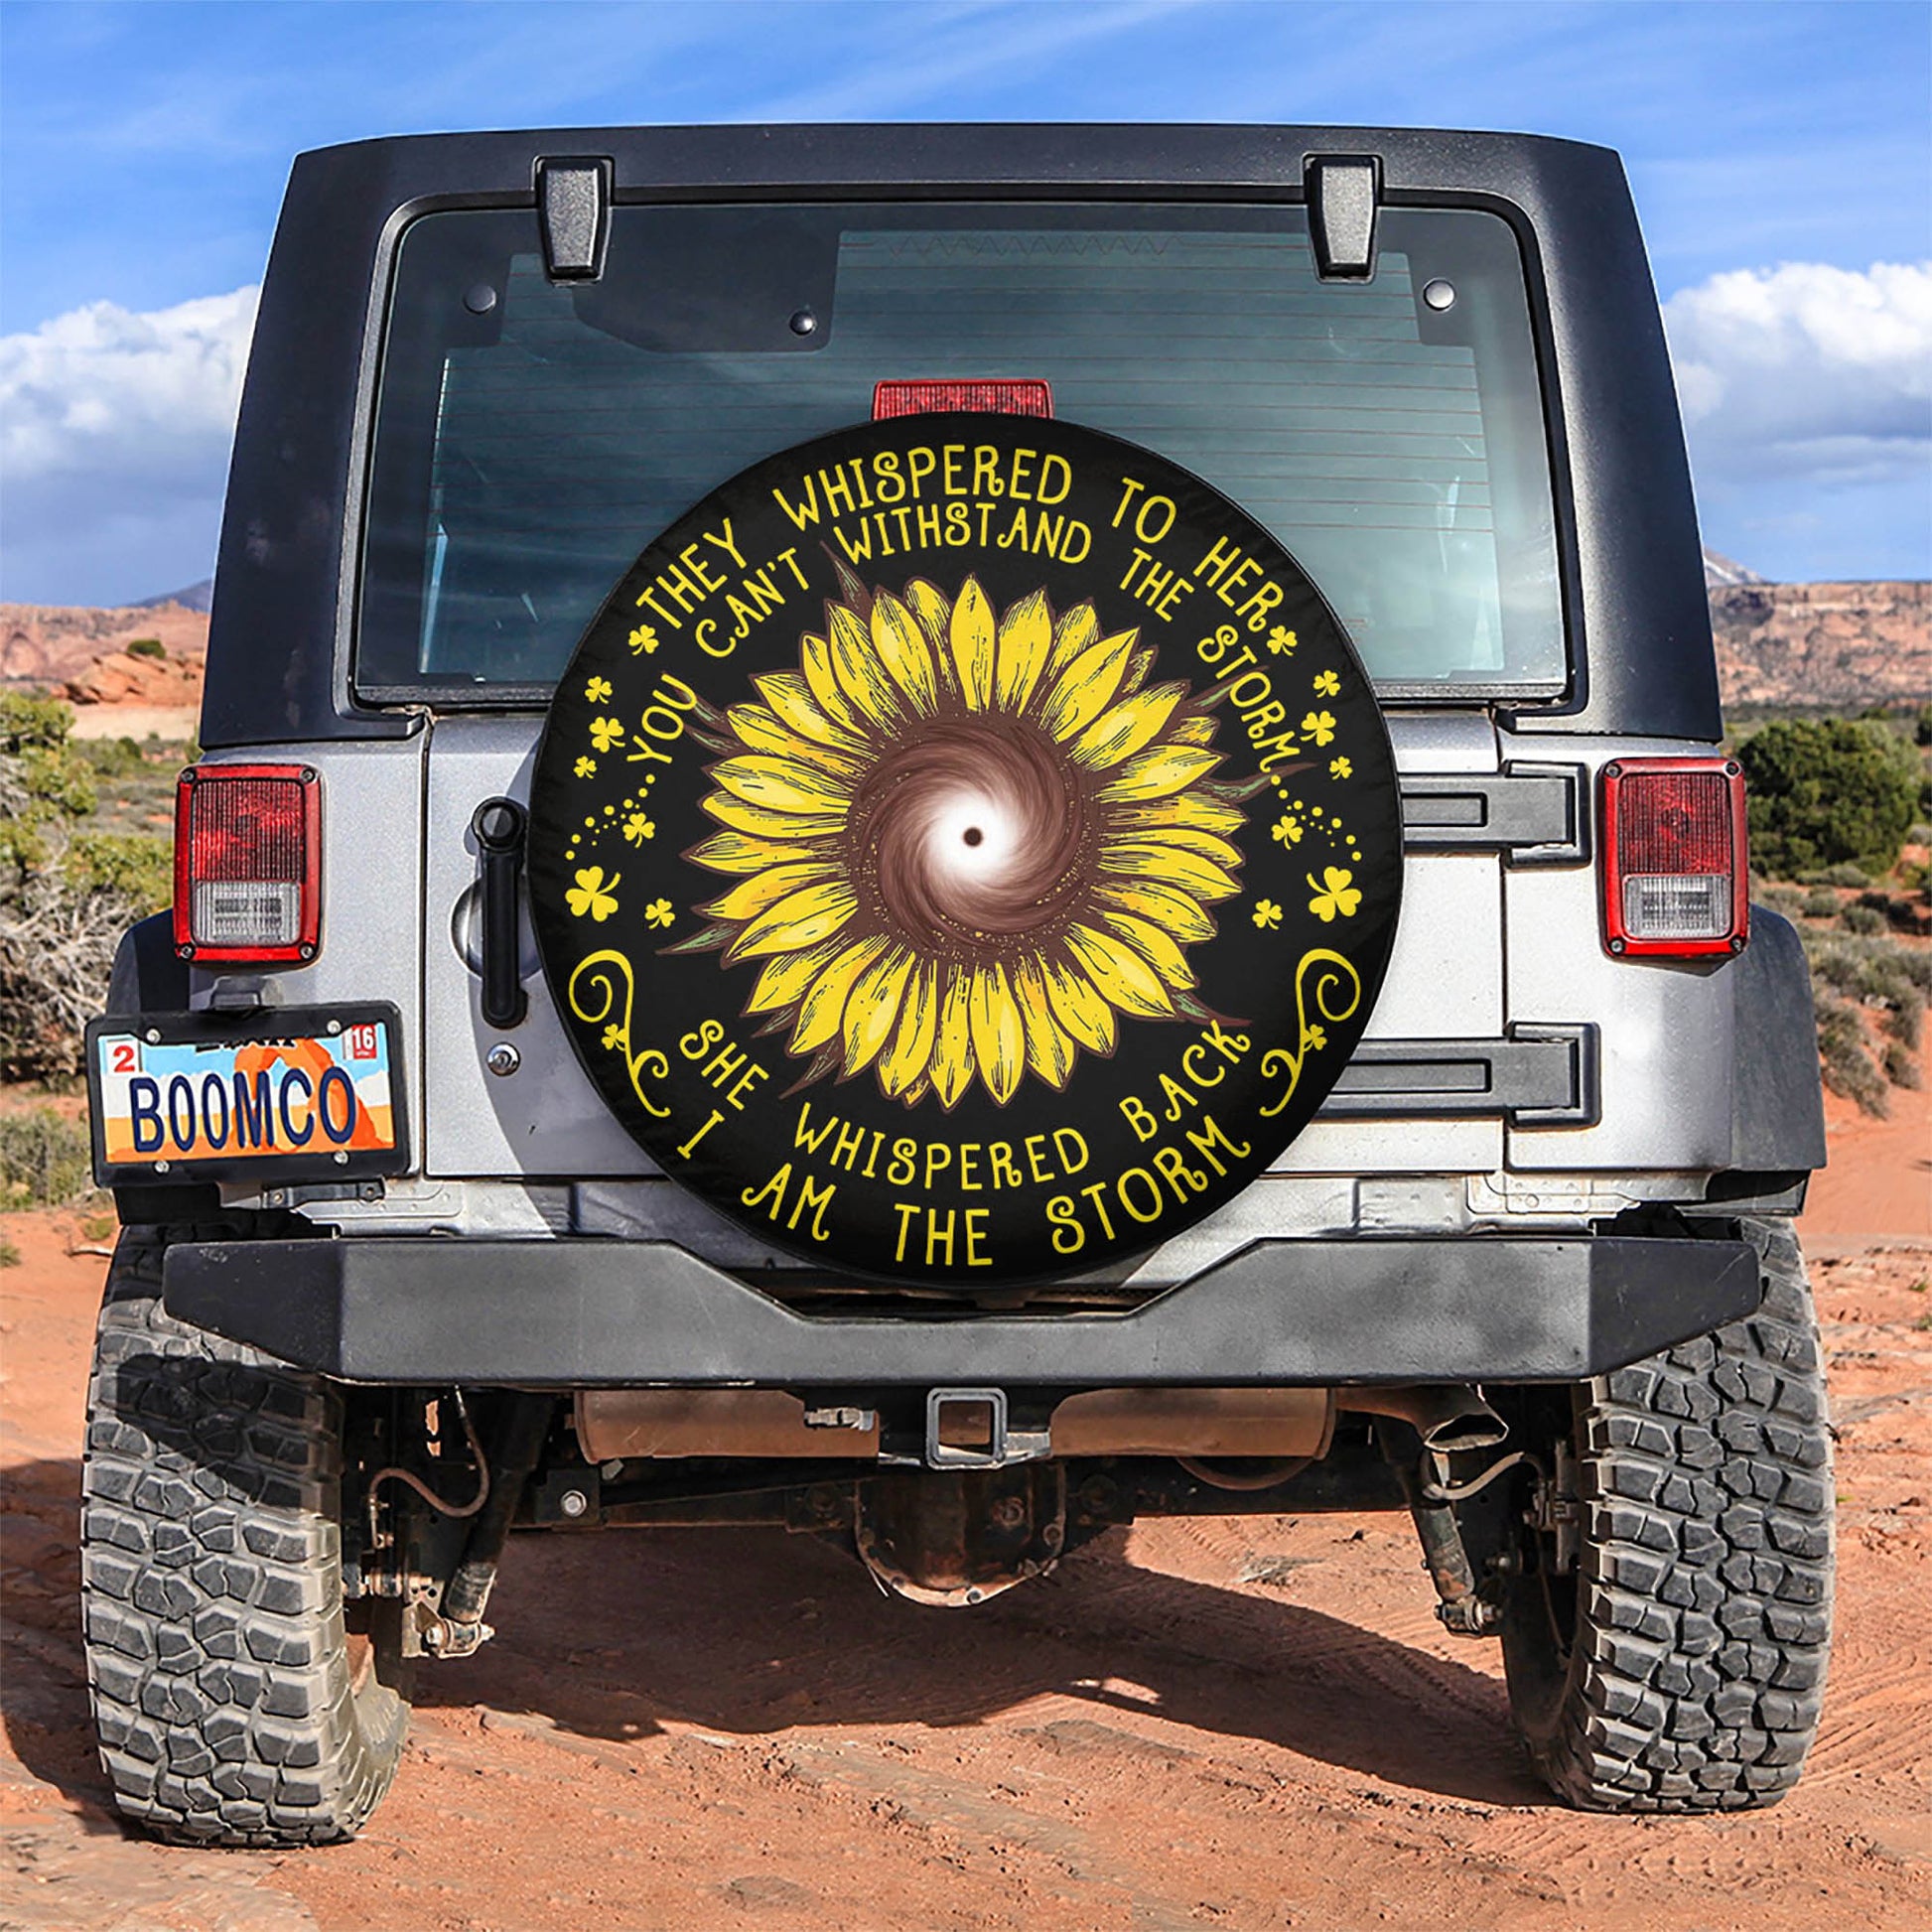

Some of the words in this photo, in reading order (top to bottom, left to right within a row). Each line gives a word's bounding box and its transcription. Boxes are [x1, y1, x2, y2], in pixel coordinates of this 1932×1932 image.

[636, 518, 747, 628] THEY
[772, 445, 1071, 530] WHISPERED
[1112, 478, 1175, 543] TO
[1193, 536, 1283, 631] HER
[627, 674, 698, 763] YOU
[696, 548, 808, 657] CAN'T
[834, 502, 1091, 564] WITHSTAND
[1120, 548, 1194, 621] THE
[1197, 625, 1300, 772] STORM
[113, 1045, 135, 1072] 2
[352, 1027, 374, 1049] 16
[680, 1020, 768, 1110] SHE
[795, 1102, 1088, 1189] WHISPERED
[1119, 1020, 1250, 1142] BACK
[677, 1110, 725, 1159] I
[742, 1164, 836, 1240] AM
[895, 1204, 992, 1265] THE
[1046, 1116, 1250, 1253] STORM
